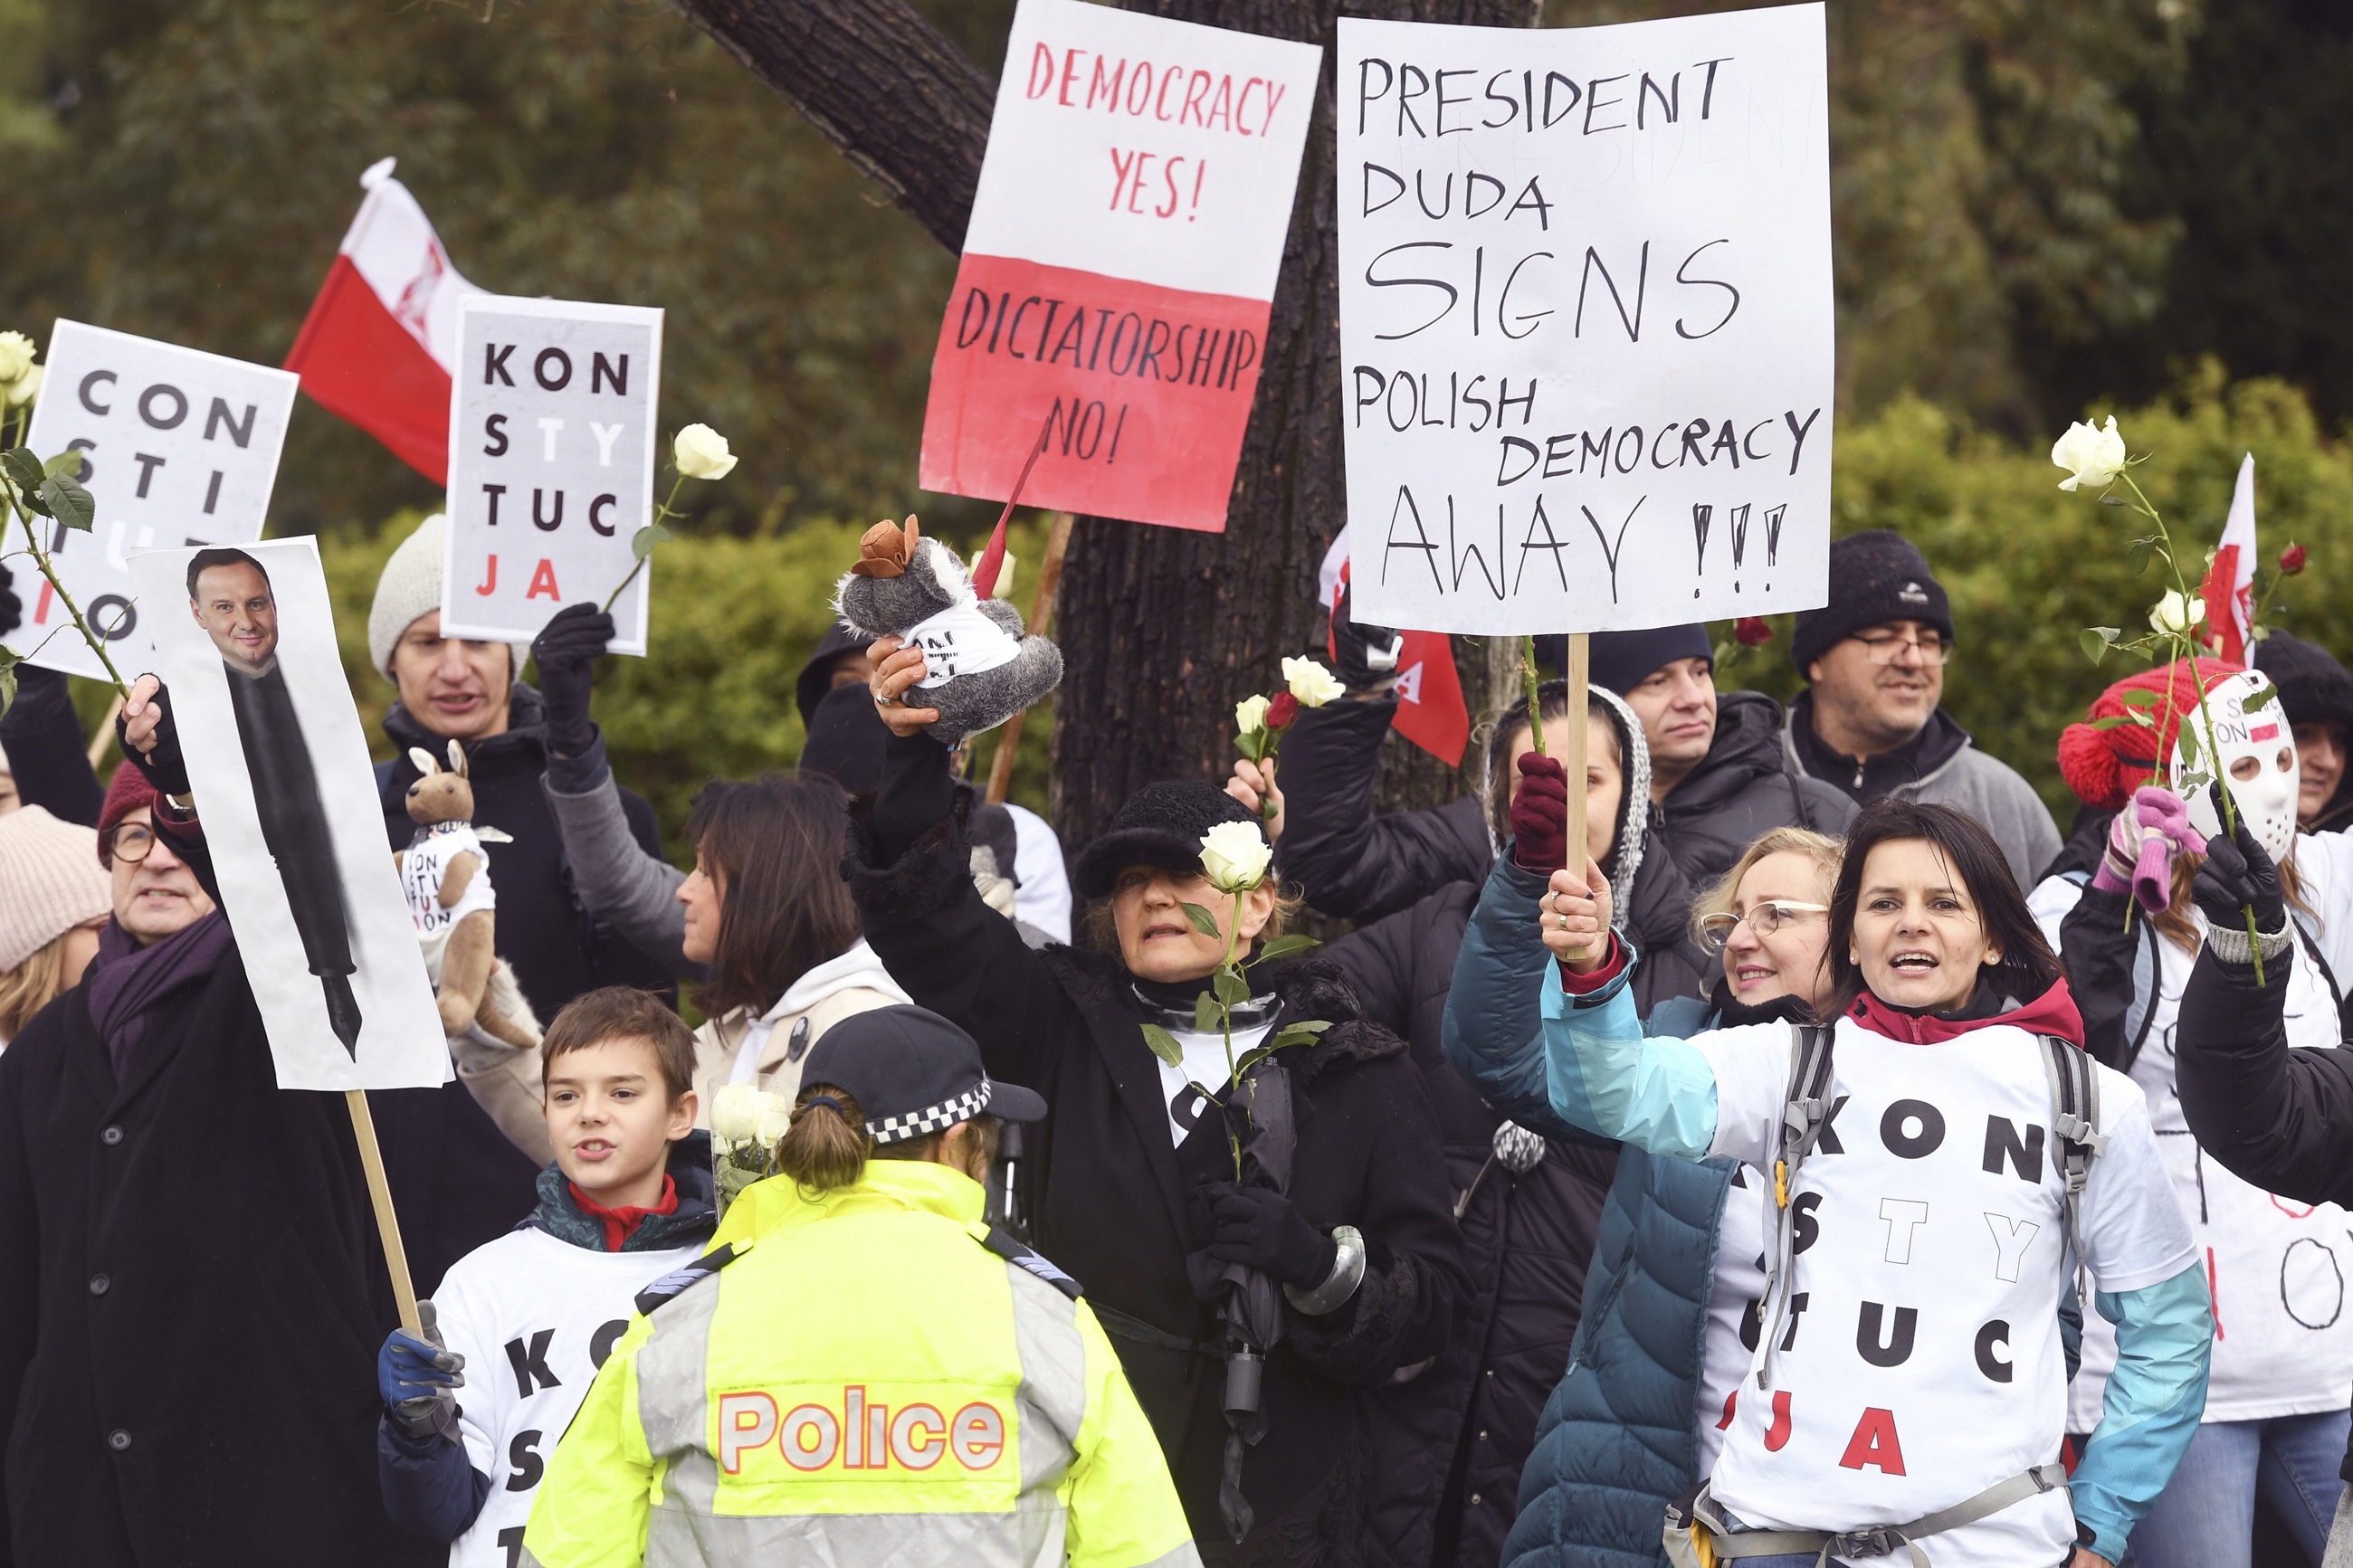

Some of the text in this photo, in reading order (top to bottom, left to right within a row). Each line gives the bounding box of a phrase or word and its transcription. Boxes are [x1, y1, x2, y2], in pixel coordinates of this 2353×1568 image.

[1026, 42, 1286, 138] DEMOCRACY
[1358, 57, 1734, 138] PRESIDENT
[1110, 147, 1205, 223] YES!
[1363, 161, 1555, 231] DUDA
[1365, 239, 1740, 342] SIGNS
[484, 344, 630, 396] KON
[956, 288, 1257, 391] DICTATORSHIP
[77, 369, 258, 449] CON
[1042, 396, 1129, 464] NO!
[1352, 366, 1538, 432] POLISH
[482, 413, 625, 468] STY
[1496, 407, 1821, 487] DEMOCRACY
[481, 483, 618, 537] TUC
[1381, 484, 1647, 603] AWAY
[475, 553, 562, 603] JA
[719, 1384, 1005, 1476] Police
[1763, 1390, 1907, 1478] JA
